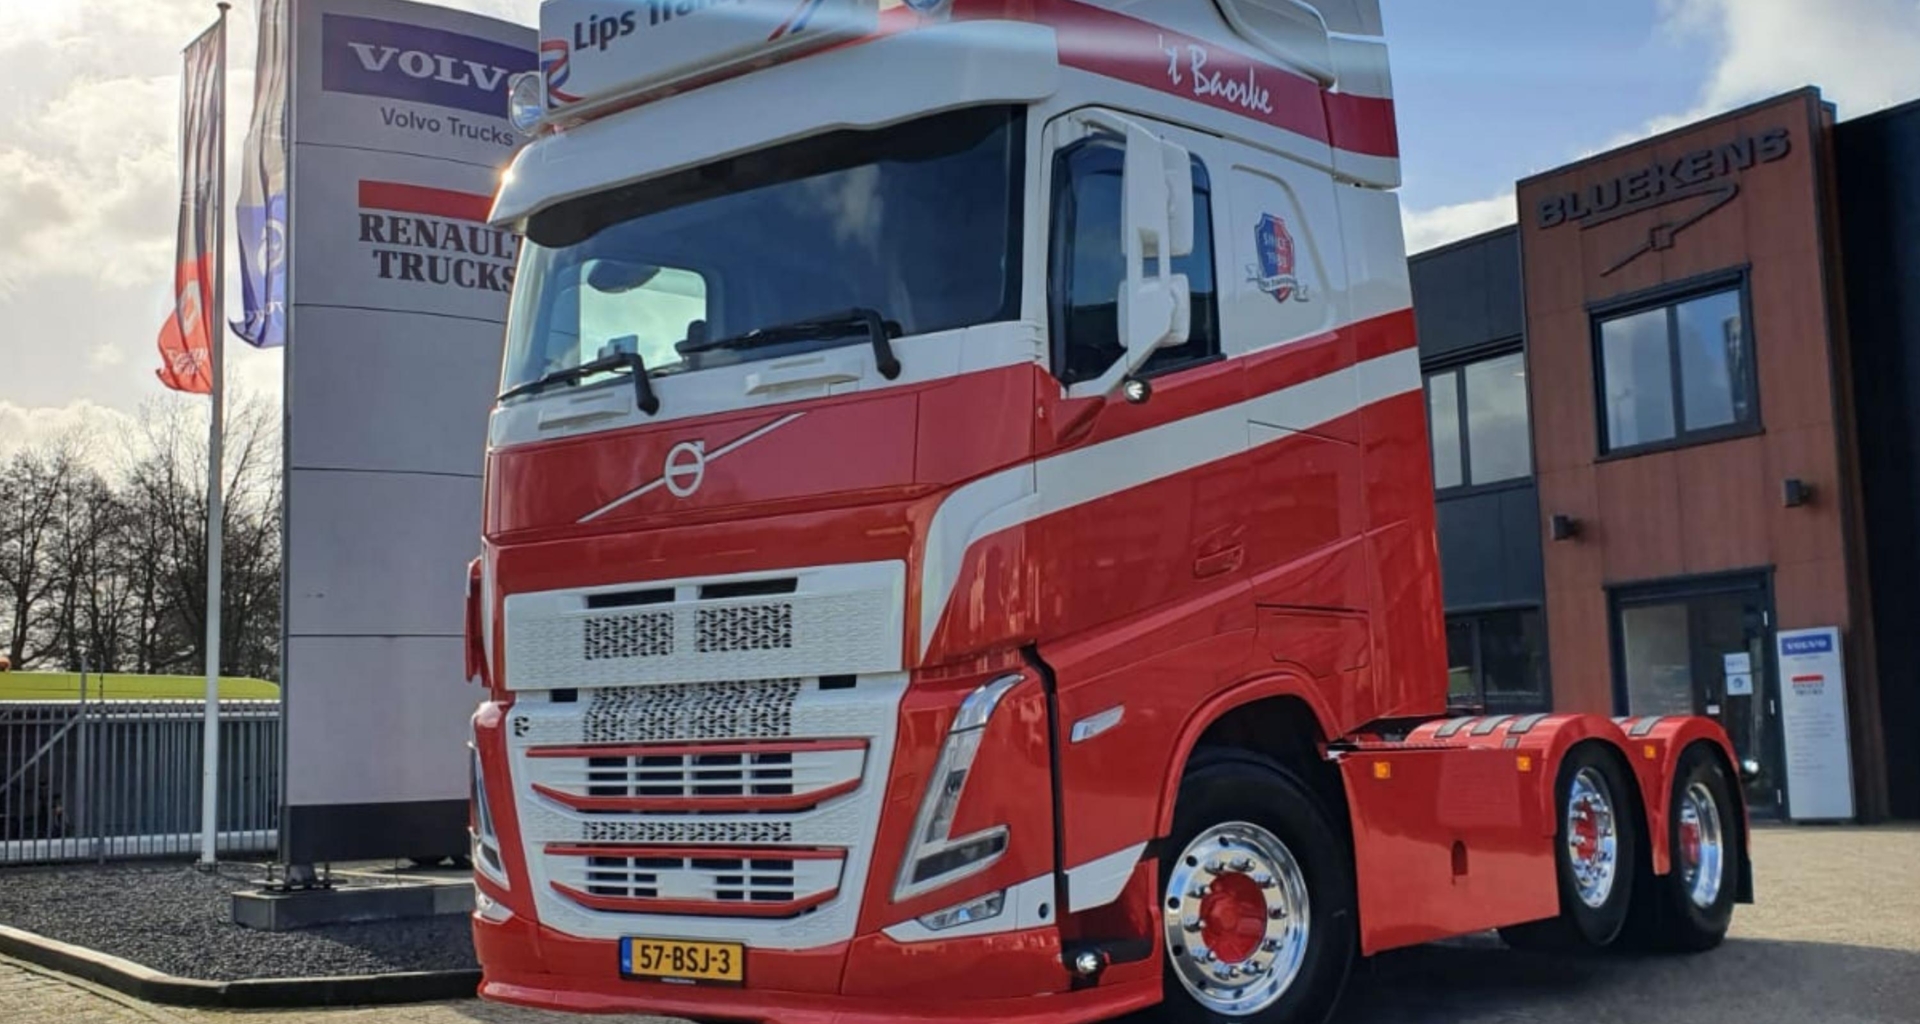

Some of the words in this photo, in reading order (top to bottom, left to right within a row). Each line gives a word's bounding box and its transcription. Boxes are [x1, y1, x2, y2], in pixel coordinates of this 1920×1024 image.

[574, 10, 636, 50] Lips
[347, 42, 509, 92] VOLV
[381, 107, 441, 133] Volvo
[447, 116, 514, 146] Trucks
[1537, 128, 1792, 230] BLUEKENS
[640, 943, 731, 975] 57-BSJ-3
